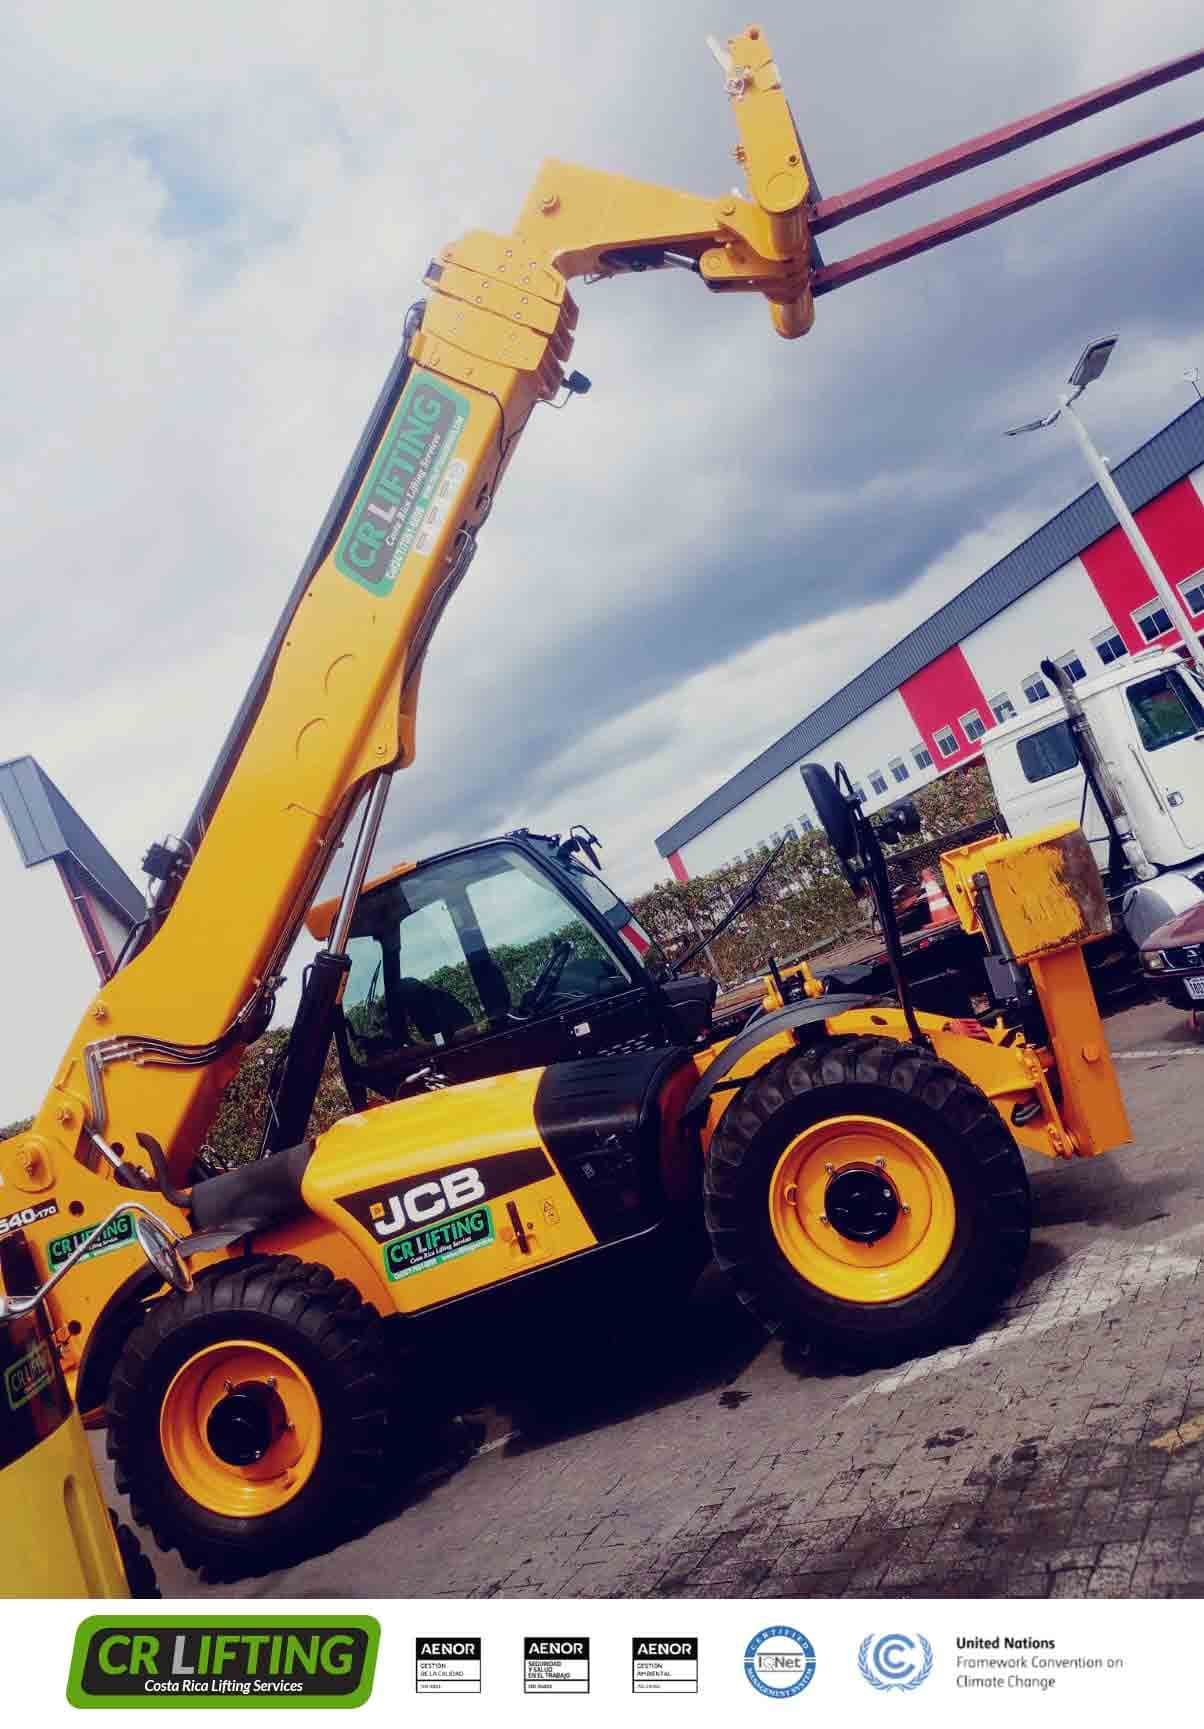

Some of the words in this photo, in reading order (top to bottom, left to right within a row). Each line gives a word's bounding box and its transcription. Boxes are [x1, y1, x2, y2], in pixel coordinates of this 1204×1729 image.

[350, 520, 386, 568] CR
[368, 395, 441, 524] LIFTING
[374, 1167, 485, 1235] JCB
[53, 1238, 72, 1257] CR
[390, 1240, 415, 1264] CR
[416, 1212, 484, 1253] LIFTING
